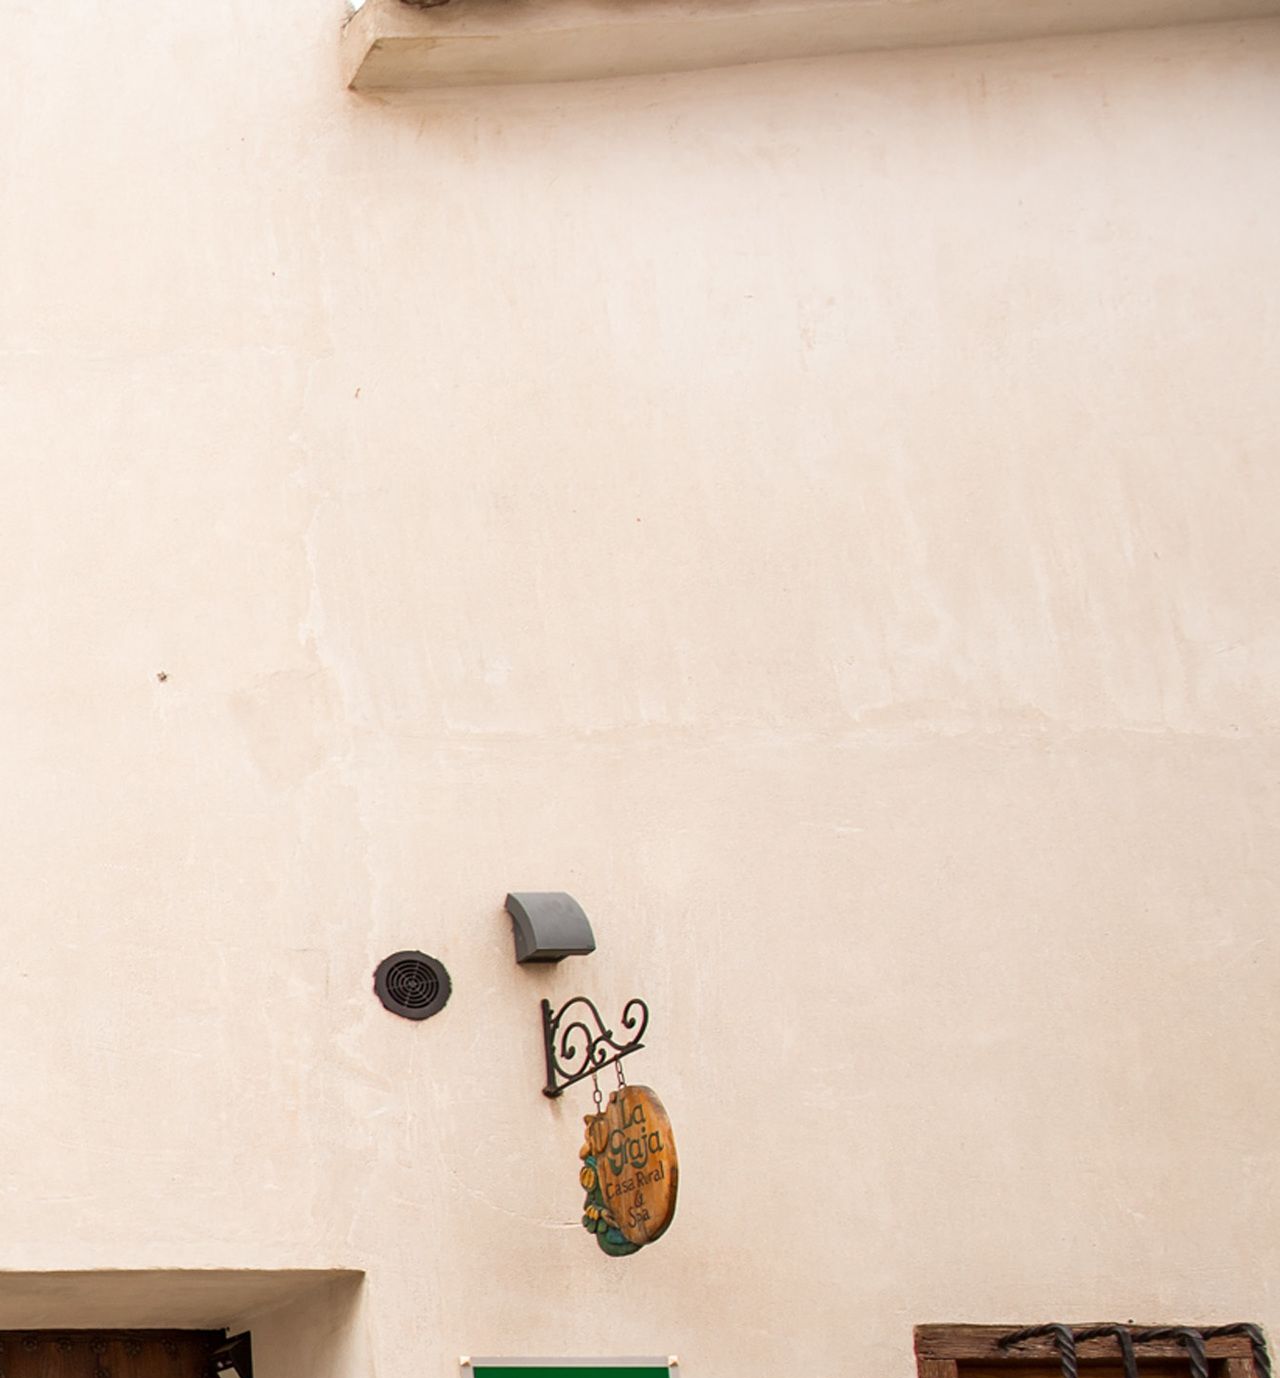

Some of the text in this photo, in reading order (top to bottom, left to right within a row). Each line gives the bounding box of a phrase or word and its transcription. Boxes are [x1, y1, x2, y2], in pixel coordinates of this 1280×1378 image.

[620, 1099, 646, 1129] La
[605, 1161, 665, 1200] Casa Rural
[627, 1207, 651, 1228] Spa
